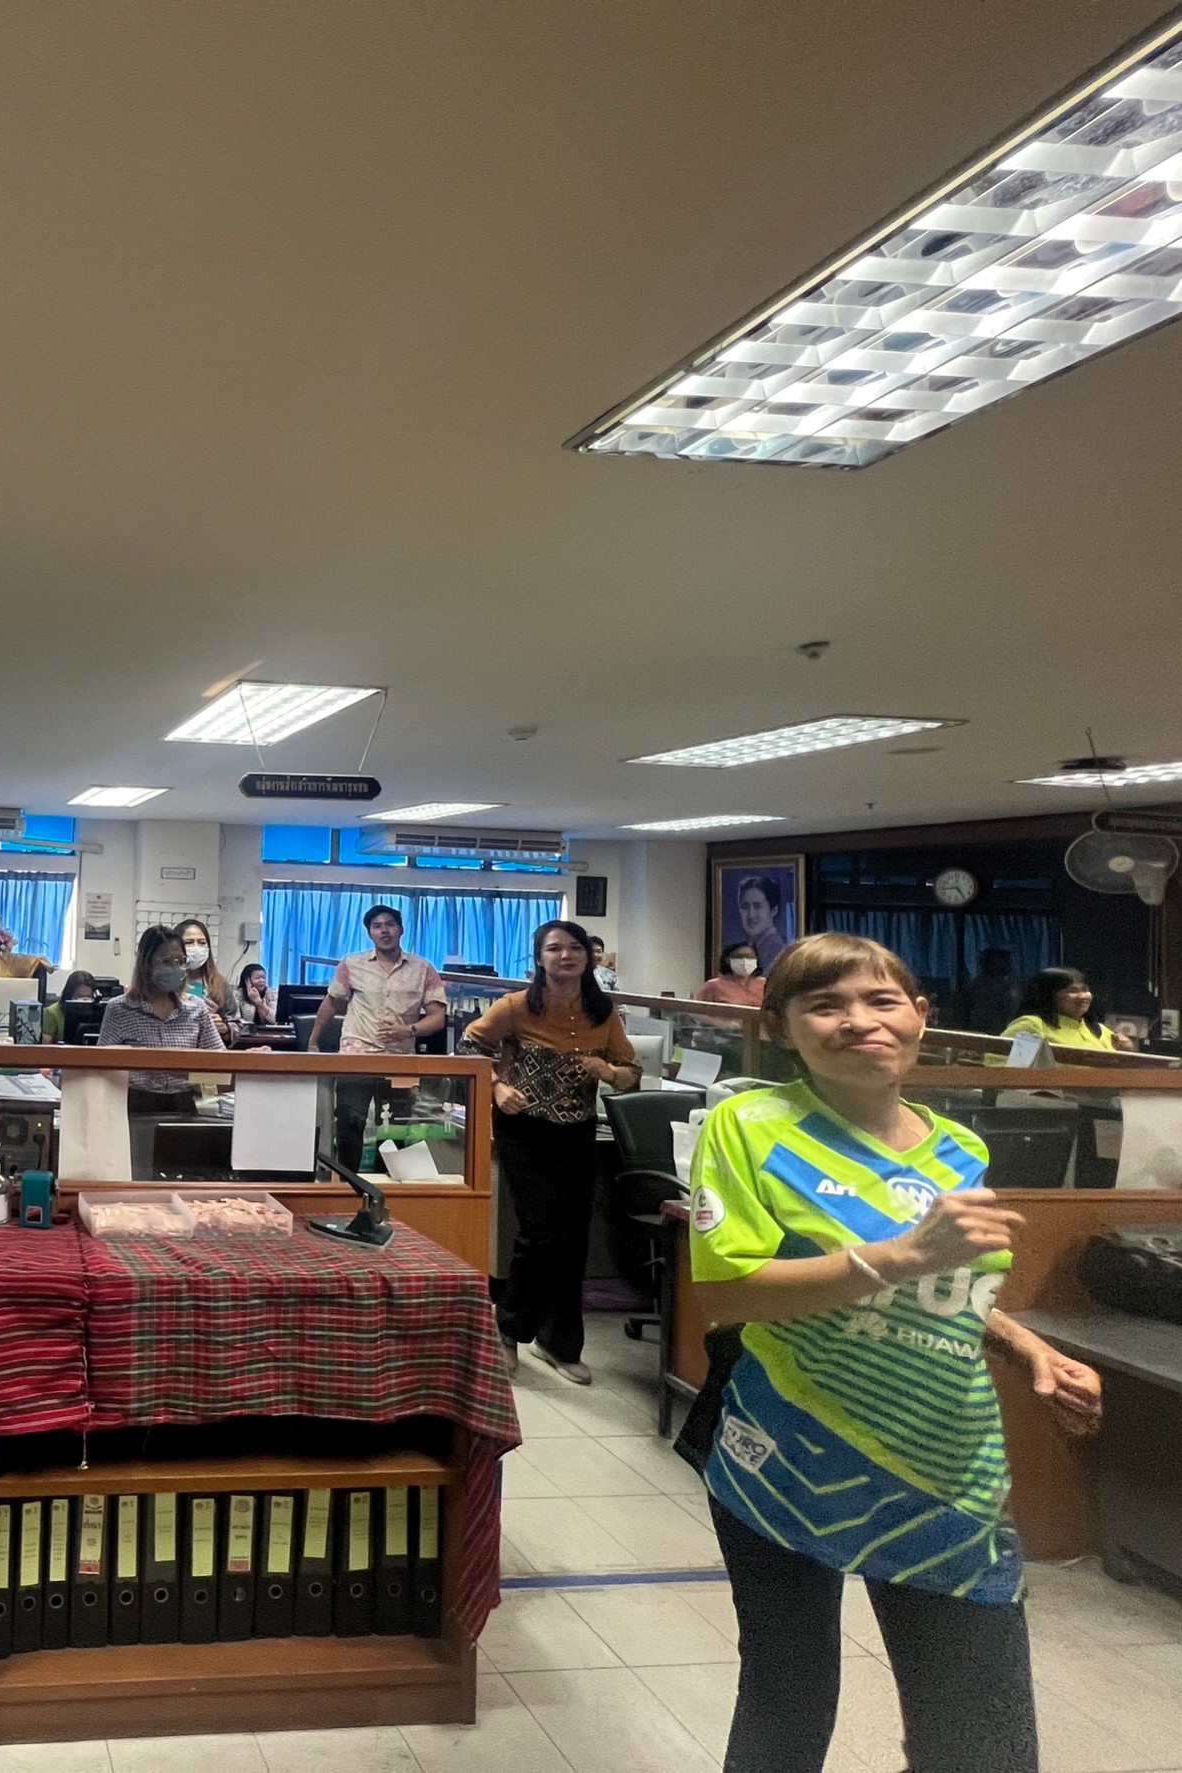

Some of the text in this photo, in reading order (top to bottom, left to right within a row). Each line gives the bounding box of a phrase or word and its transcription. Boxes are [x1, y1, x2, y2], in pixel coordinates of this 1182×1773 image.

[255, 776, 369, 796] กลุ่มงานส่งเสริมการพัฒนาชุมชน
[816, 1179, 857, 1197] Ari
[897, 1328, 981, 1360] HUAW
